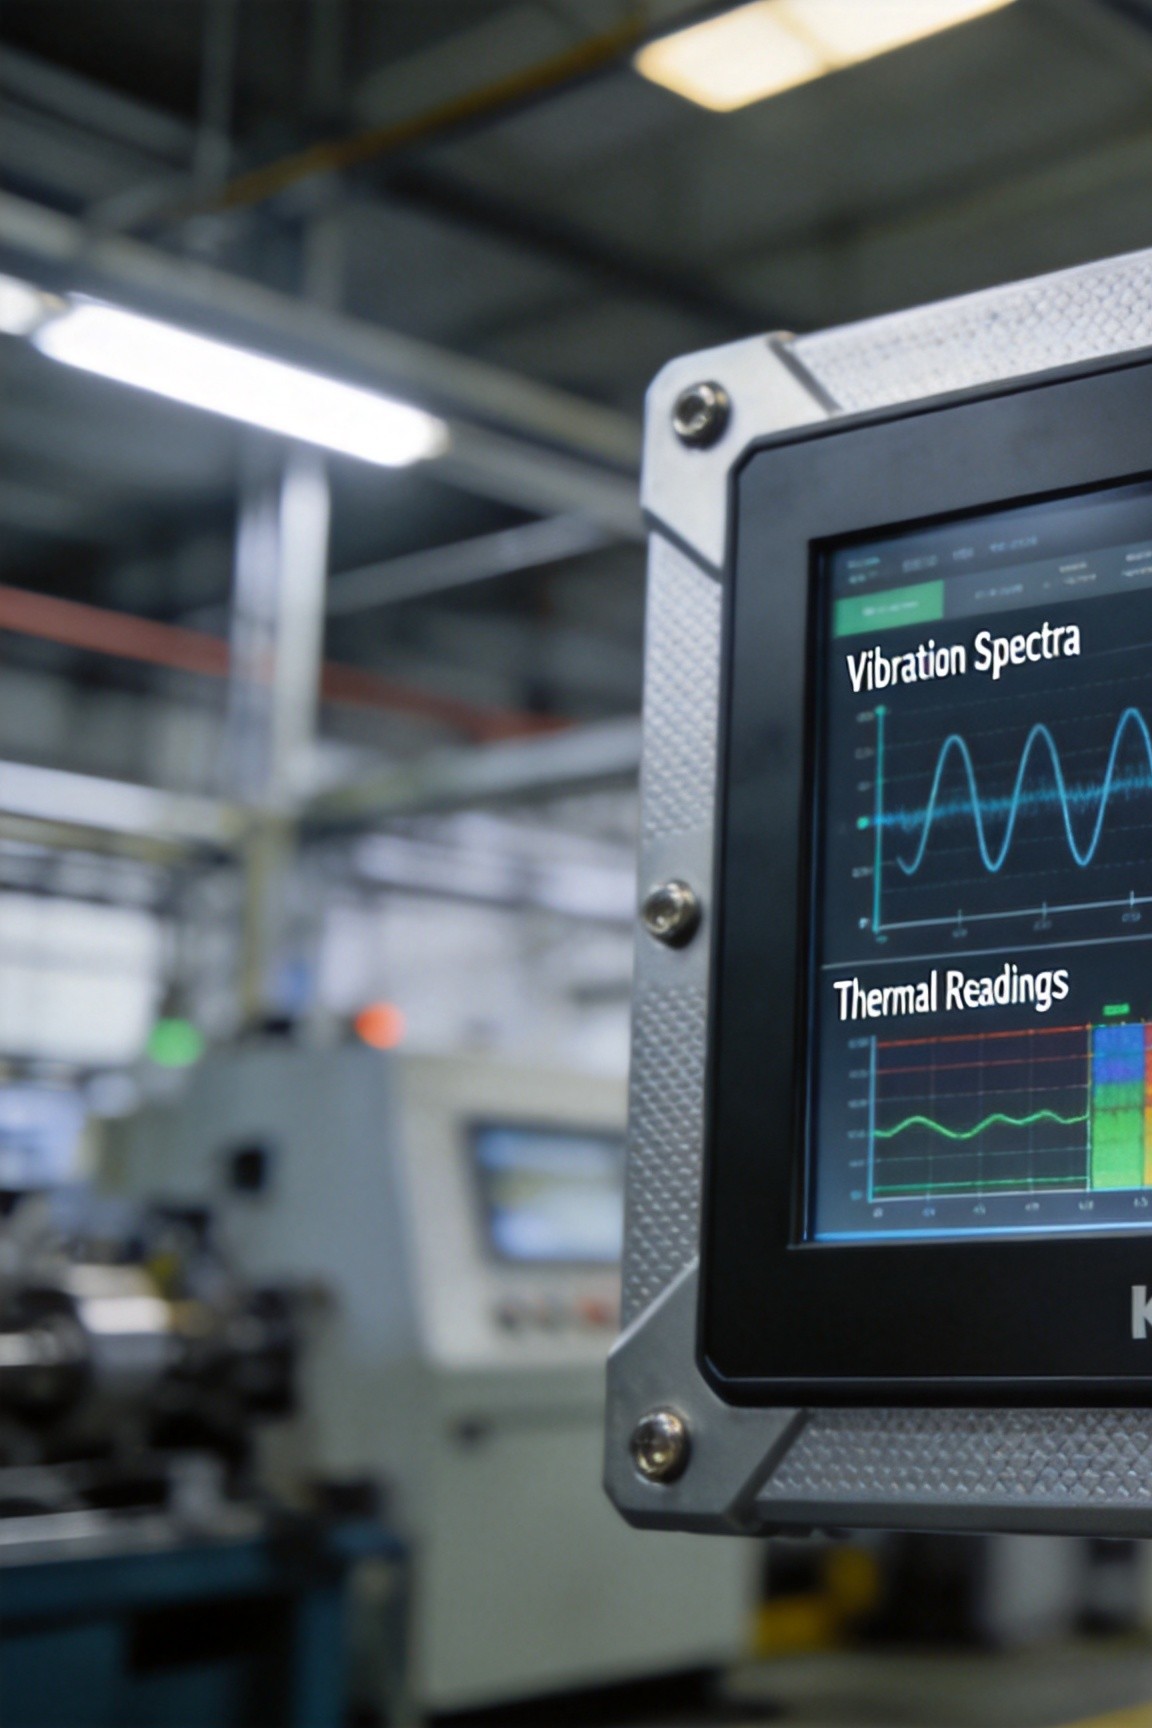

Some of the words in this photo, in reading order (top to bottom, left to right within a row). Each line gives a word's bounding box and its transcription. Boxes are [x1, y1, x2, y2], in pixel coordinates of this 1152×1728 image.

[846, 639, 967, 693] Vibration
[973, 623, 1081, 680] Spectra
[834, 969, 938, 1021] Thermal
[945, 963, 1070, 1014] Readings
